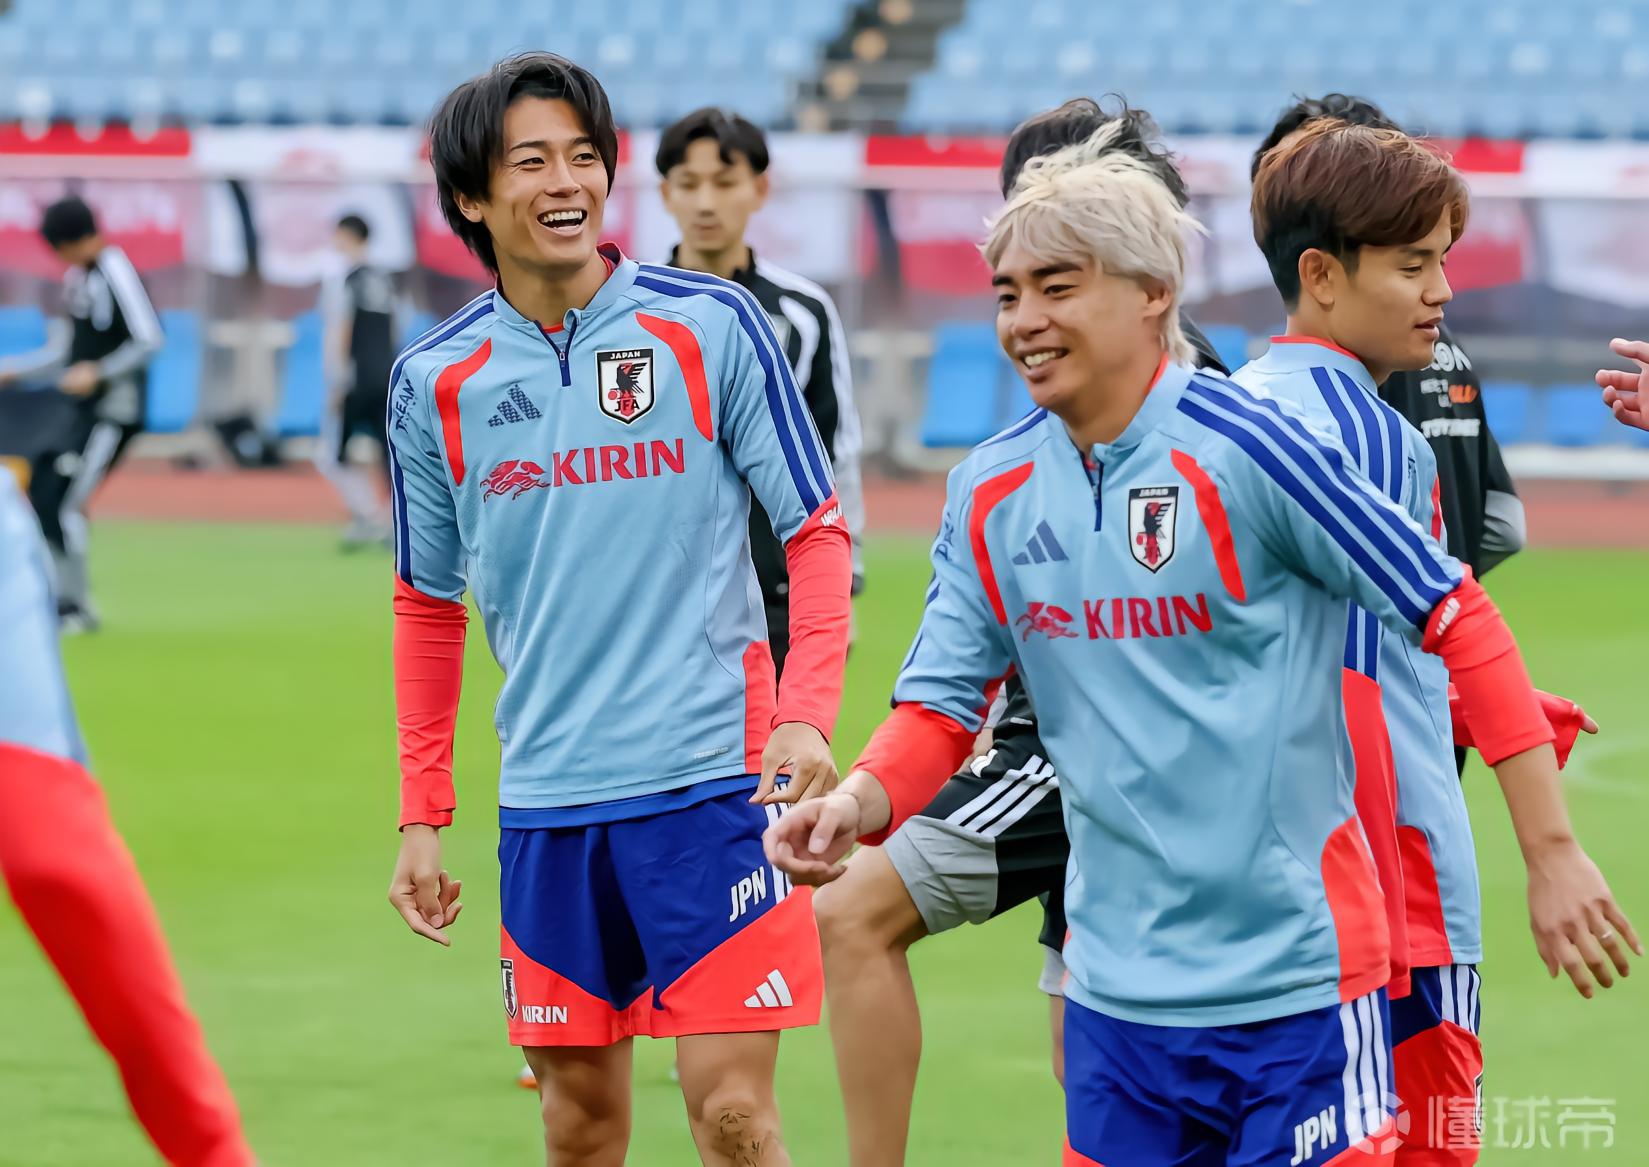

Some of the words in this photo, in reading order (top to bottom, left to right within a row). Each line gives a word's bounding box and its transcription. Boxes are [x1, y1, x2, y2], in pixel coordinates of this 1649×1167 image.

[610, 351, 640, 360] JAPAN
[552, 438, 684, 487] KIRIN
[1083, 592, 1213, 640] KIRIN
[730, 866, 766, 922] JPN
[522, 1005, 567, 1024] KIRIN
[1291, 1105, 1336, 1167] JPN
